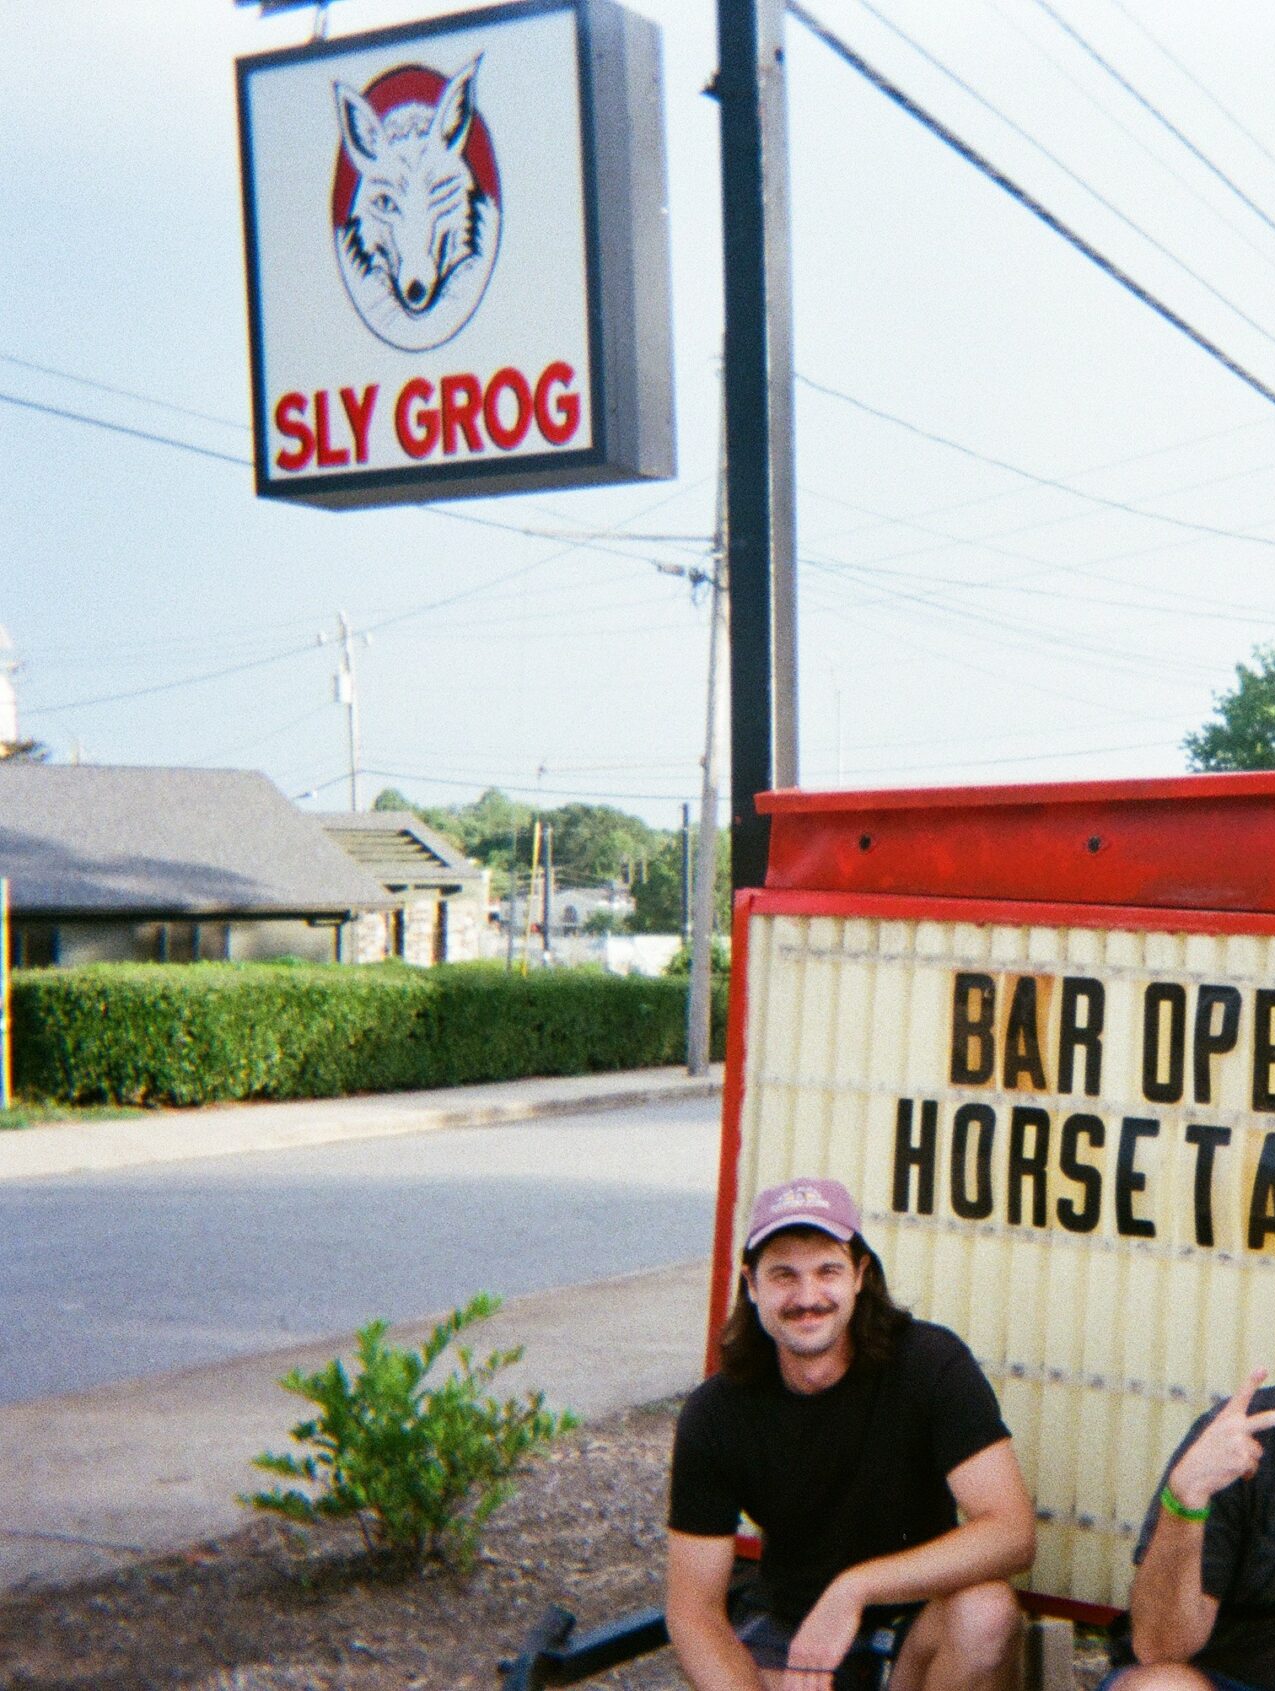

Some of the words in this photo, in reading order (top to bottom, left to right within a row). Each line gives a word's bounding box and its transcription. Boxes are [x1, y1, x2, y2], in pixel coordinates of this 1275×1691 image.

[274, 385, 379, 471] SLY
[394, 361, 581, 459] GROG
[950, 972, 1105, 1096] BAR
